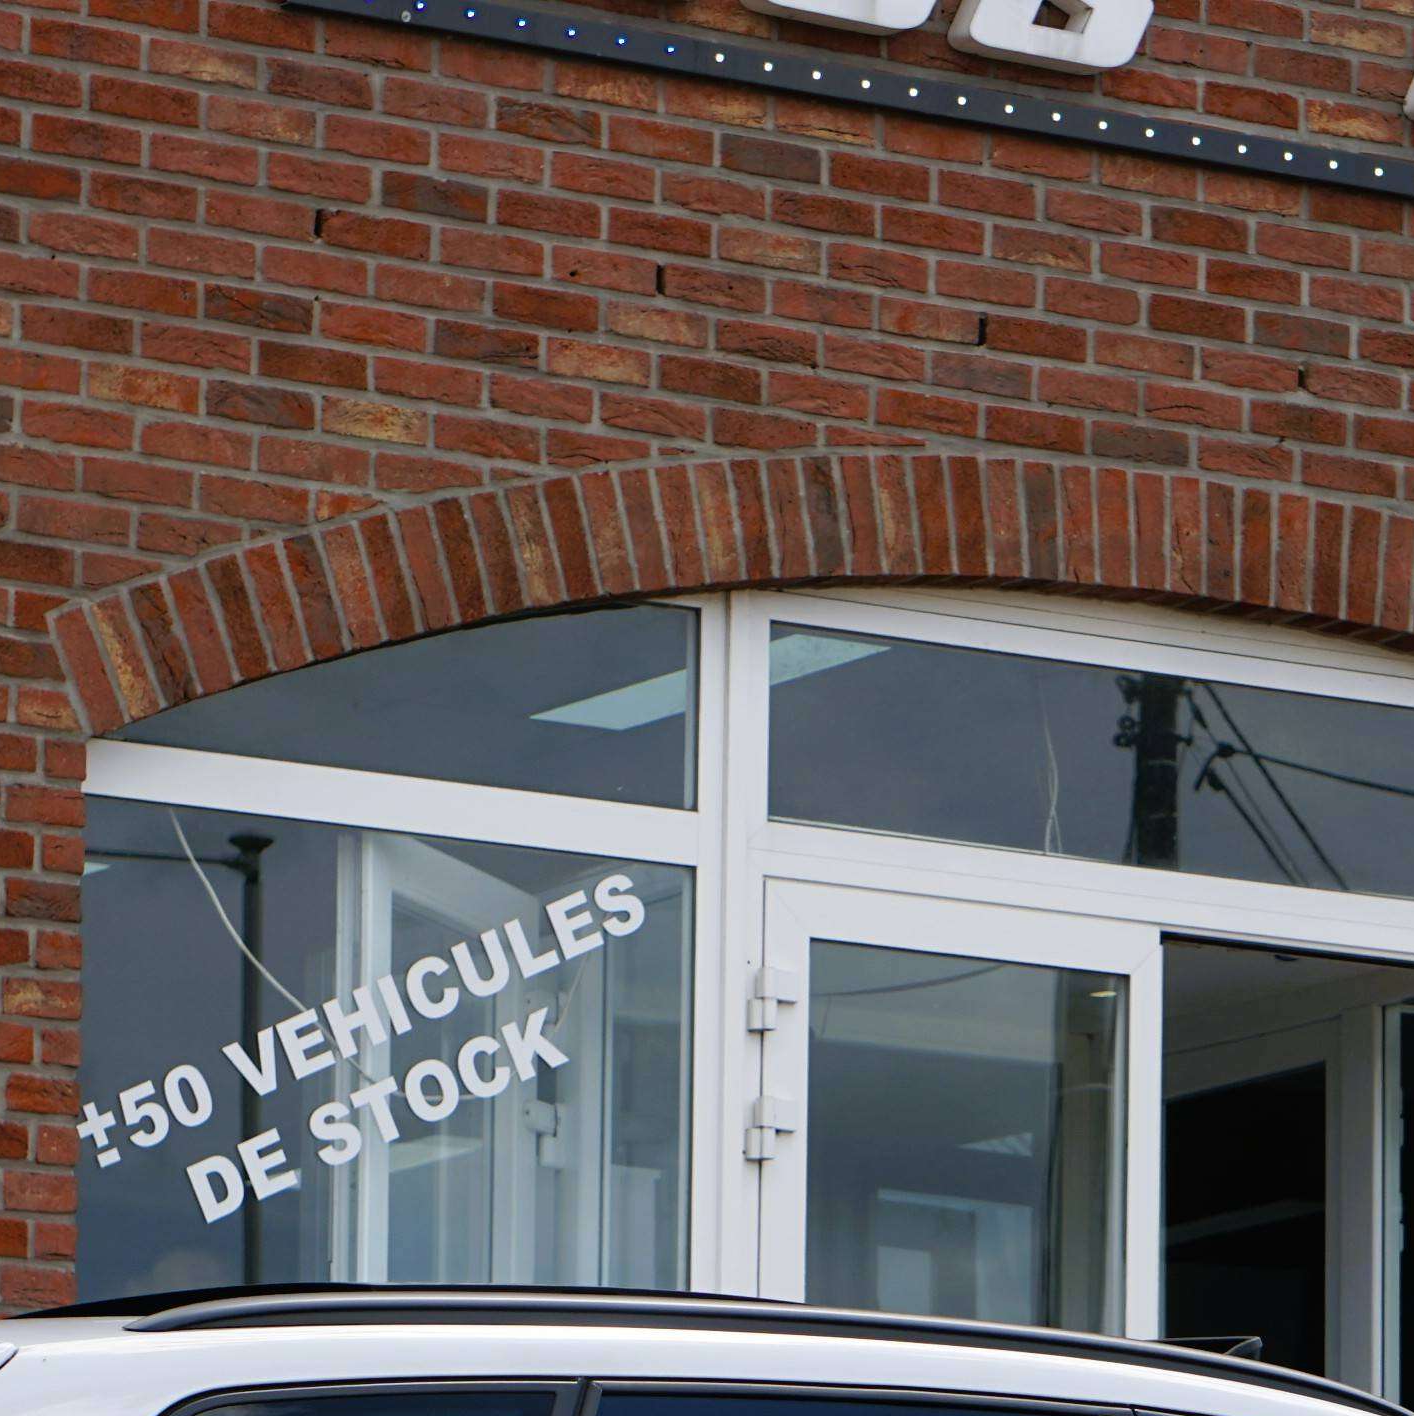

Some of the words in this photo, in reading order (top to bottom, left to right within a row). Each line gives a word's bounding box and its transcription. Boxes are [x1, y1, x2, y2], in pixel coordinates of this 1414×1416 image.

[222, 874, 646, 1096] VEHICULES
[186, 1128, 299, 1224] DE
[309, 1007, 570, 1166] STOCK
